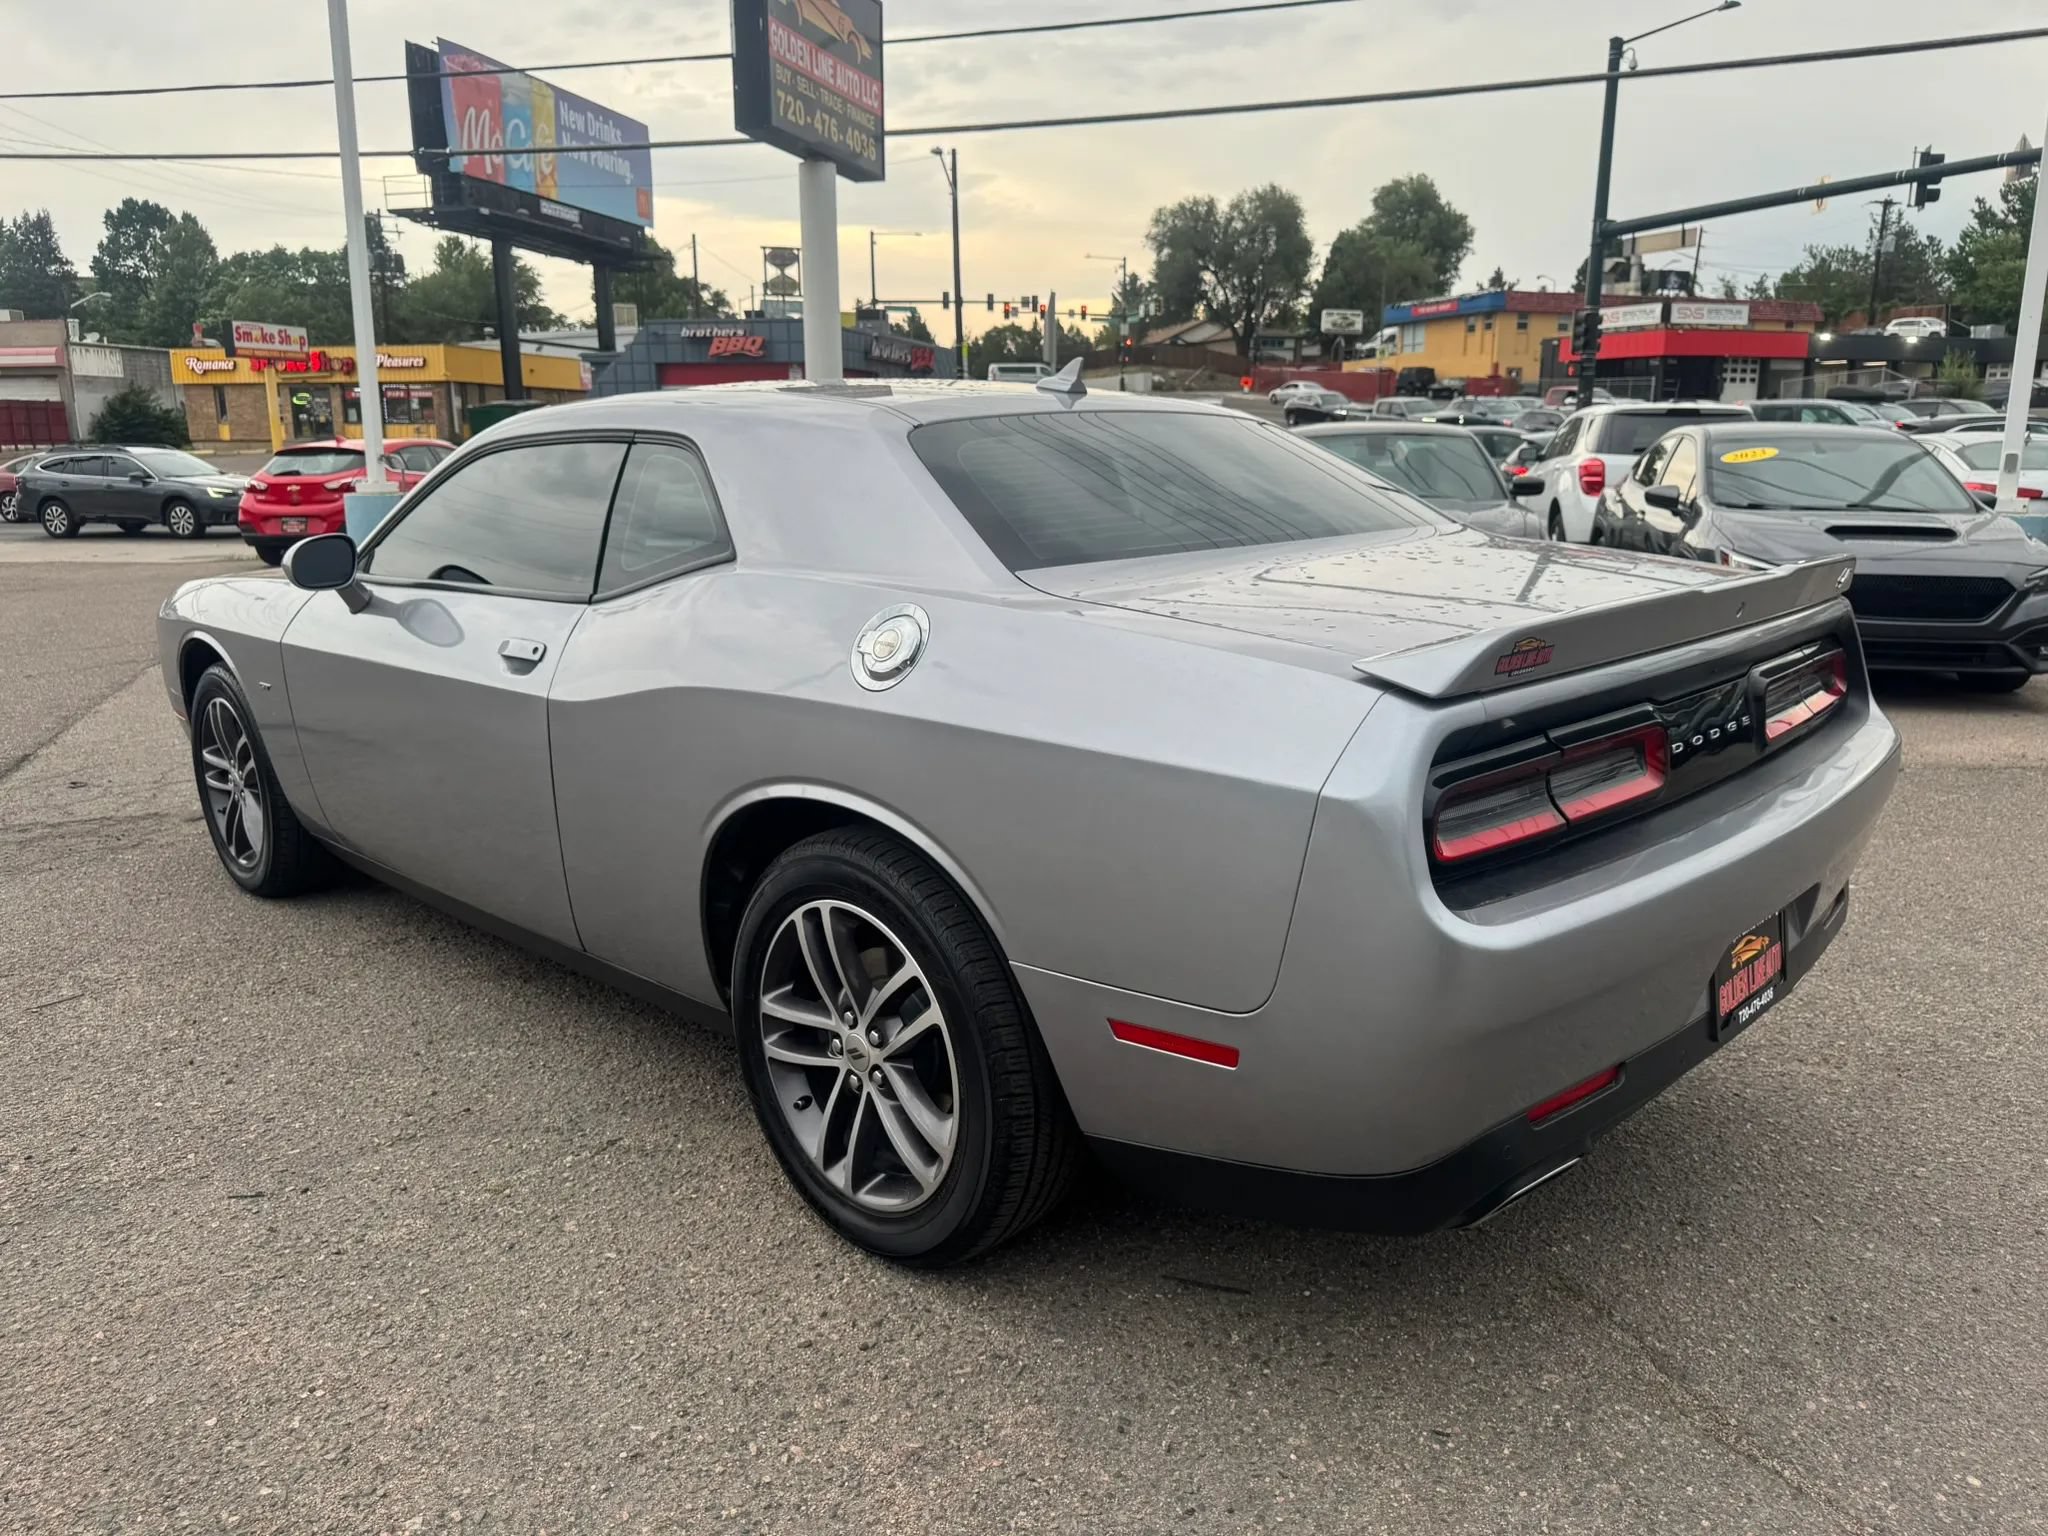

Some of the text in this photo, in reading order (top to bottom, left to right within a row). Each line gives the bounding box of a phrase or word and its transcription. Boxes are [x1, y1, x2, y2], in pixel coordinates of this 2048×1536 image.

[770, 23, 879, 108] GOLDEN LINE AUTO LLC
[775, 63, 791, 86] BUY
[796, 76, 816, 99] SELL
[559, 101, 622, 143] New Drinks
[562, 131, 587, 165] Now
[235, 325, 306, 351] Smoke Shop
[681, 327, 744, 338] brothers
[708, 336, 765, 357] BBQ
[186, 357, 235, 374] Romance
[376, 353, 424, 368] Pleasures
[1672, 715, 1751, 754] DODGE
[1719, 966, 1749, 1016] GOLDEN
[1748, 953, 1767, 994] LINE
